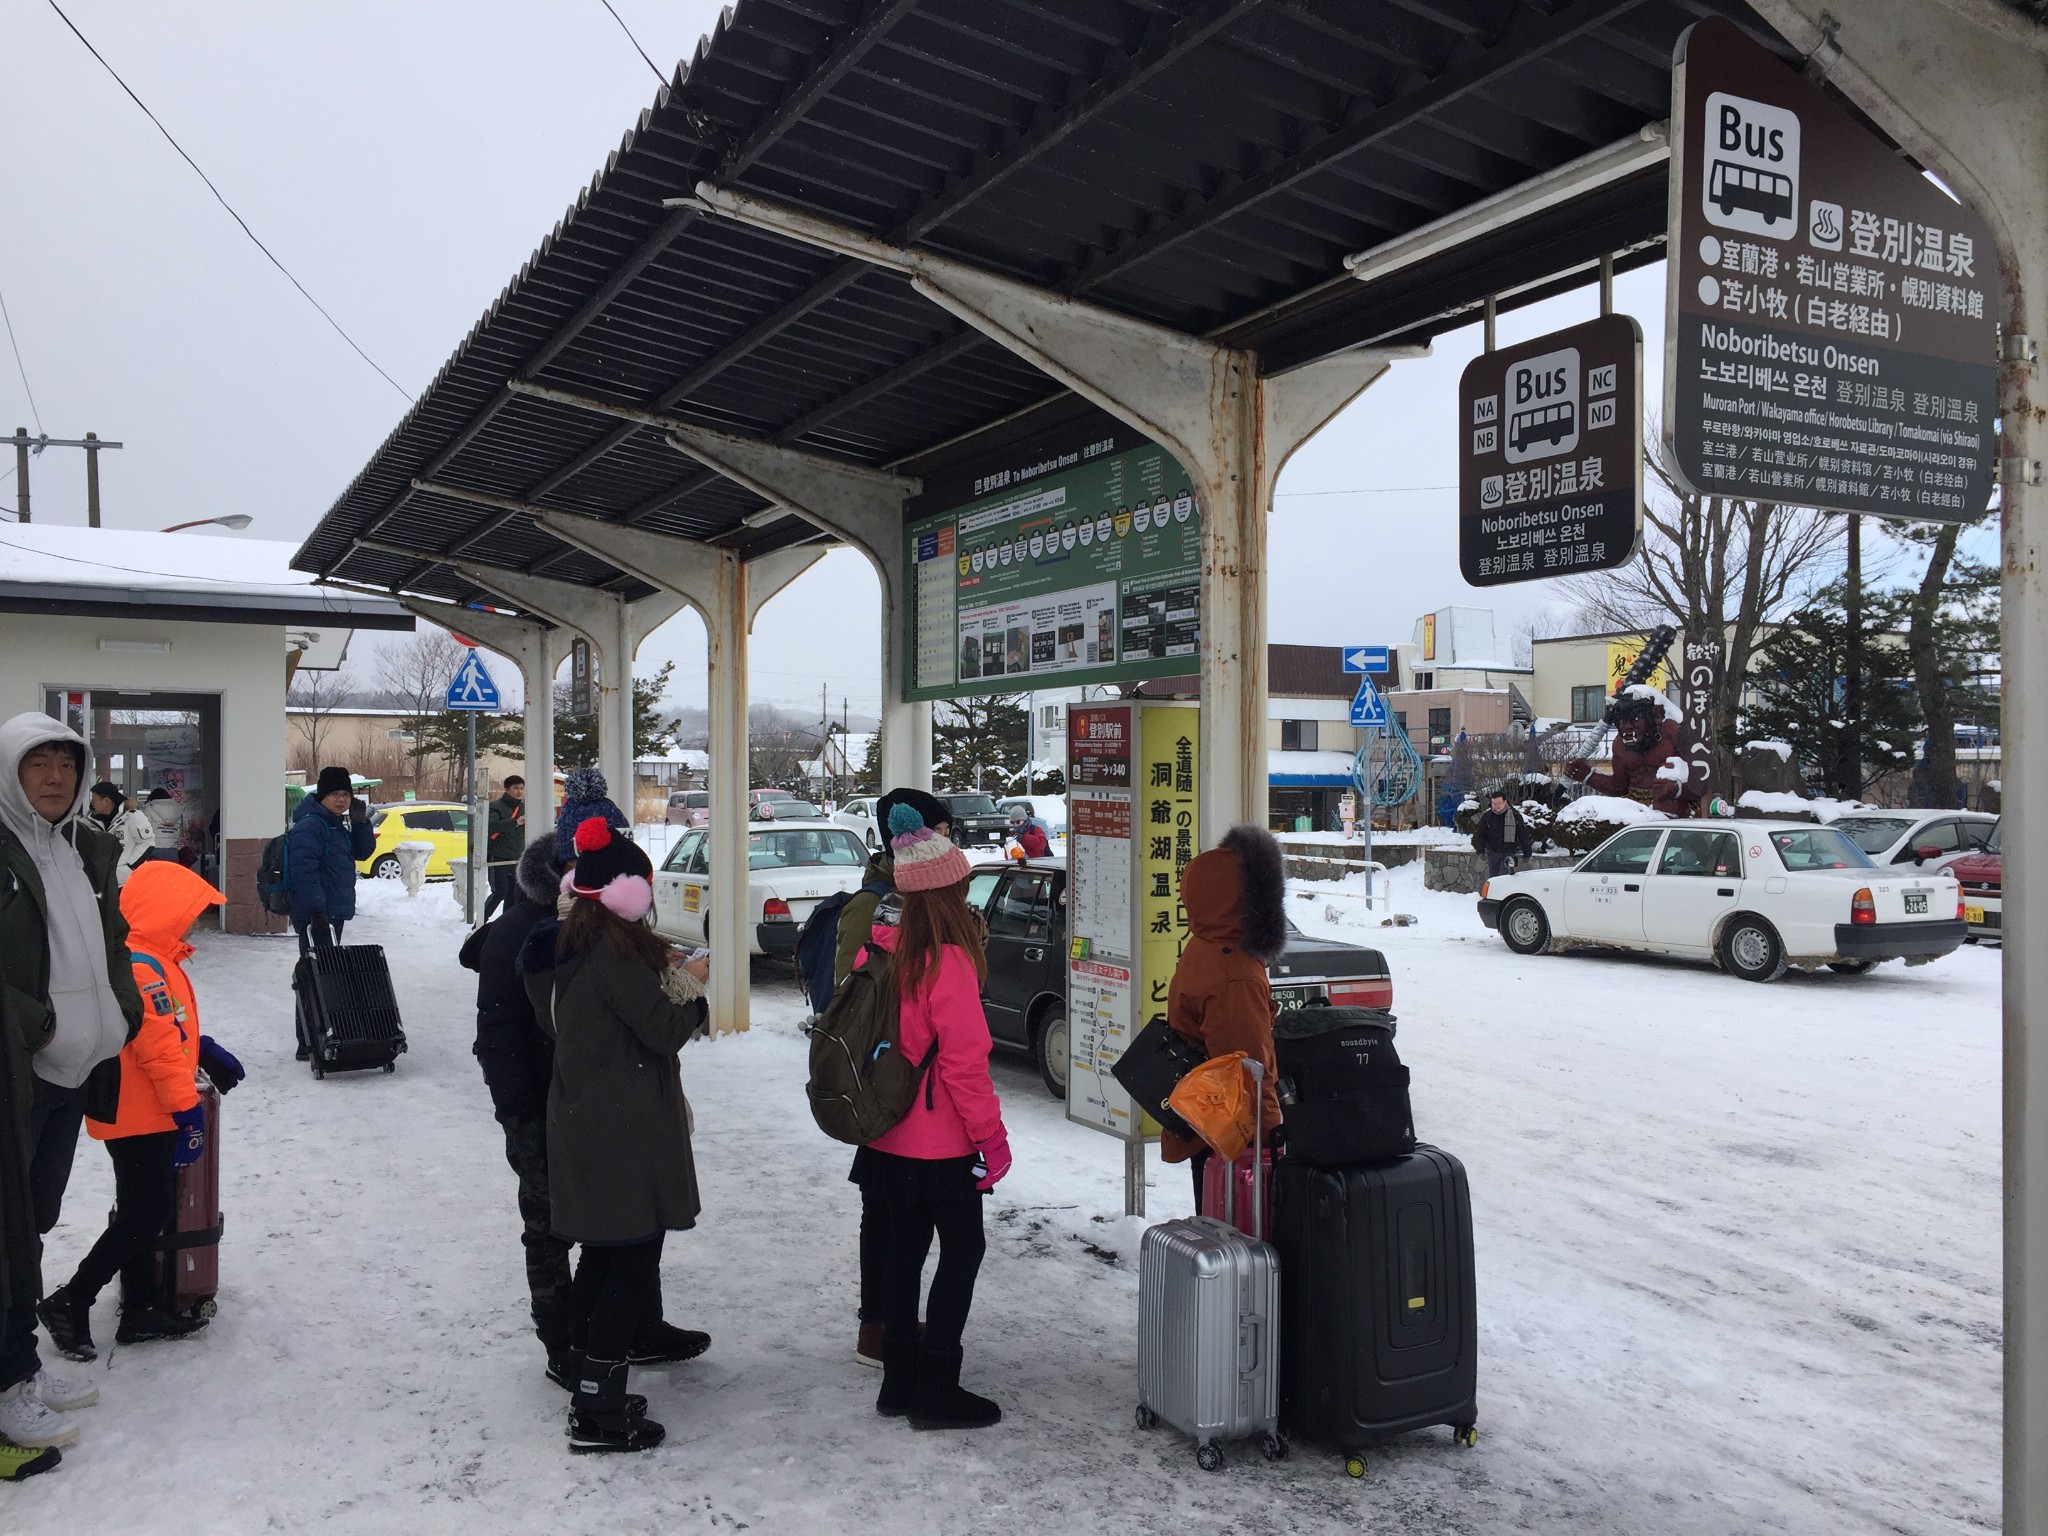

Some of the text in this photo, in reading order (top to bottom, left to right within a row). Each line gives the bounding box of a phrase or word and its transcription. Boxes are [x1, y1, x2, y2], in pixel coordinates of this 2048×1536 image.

[1720, 104, 1784, 162] Bus
[1848, 208, 1977, 279] 登別温泉
[1701, 323, 1879, 377] Noboribetsu Onsen
[1516, 367, 1567, 404] Bus
[1592, 369, 1612, 391] NC
[1699, 358, 1790, 393] 노보리베쓰
[1793, 372, 1827, 401] 온천
[1477, 402, 1494, 419] NA
[1591, 404, 1612, 424] ND
[1703, 392, 1738, 413] Muroran
[1739, 398, 1756, 416] Port
[1762, 401, 1803, 424] Wakayama
[1829, 411, 1867, 432] Horobetsu
[1868, 418, 1894, 440] Library
[1899, 422, 1940, 443] Tomakomai
[1941, 428, 1953, 446] (via
[1954, 430, 1980, 451] Shiraoi)
[1477, 431, 1494, 449] NB
[1021, 458, 1058, 479] Noboribetsu
[1058, 452, 1078, 468] Onsen
[1505, 456, 1605, 505] 登別温泉
[1481, 503, 1604, 534] Noboribetsu Onsen
[1496, 522, 1585, 551] 노보리베쓰 온천
[1089, 723, 1122, 739] 登別駅前
[1686, 665, 1713, 781] のぼりべつ
[1356, 1053, 1369, 1065] 77
